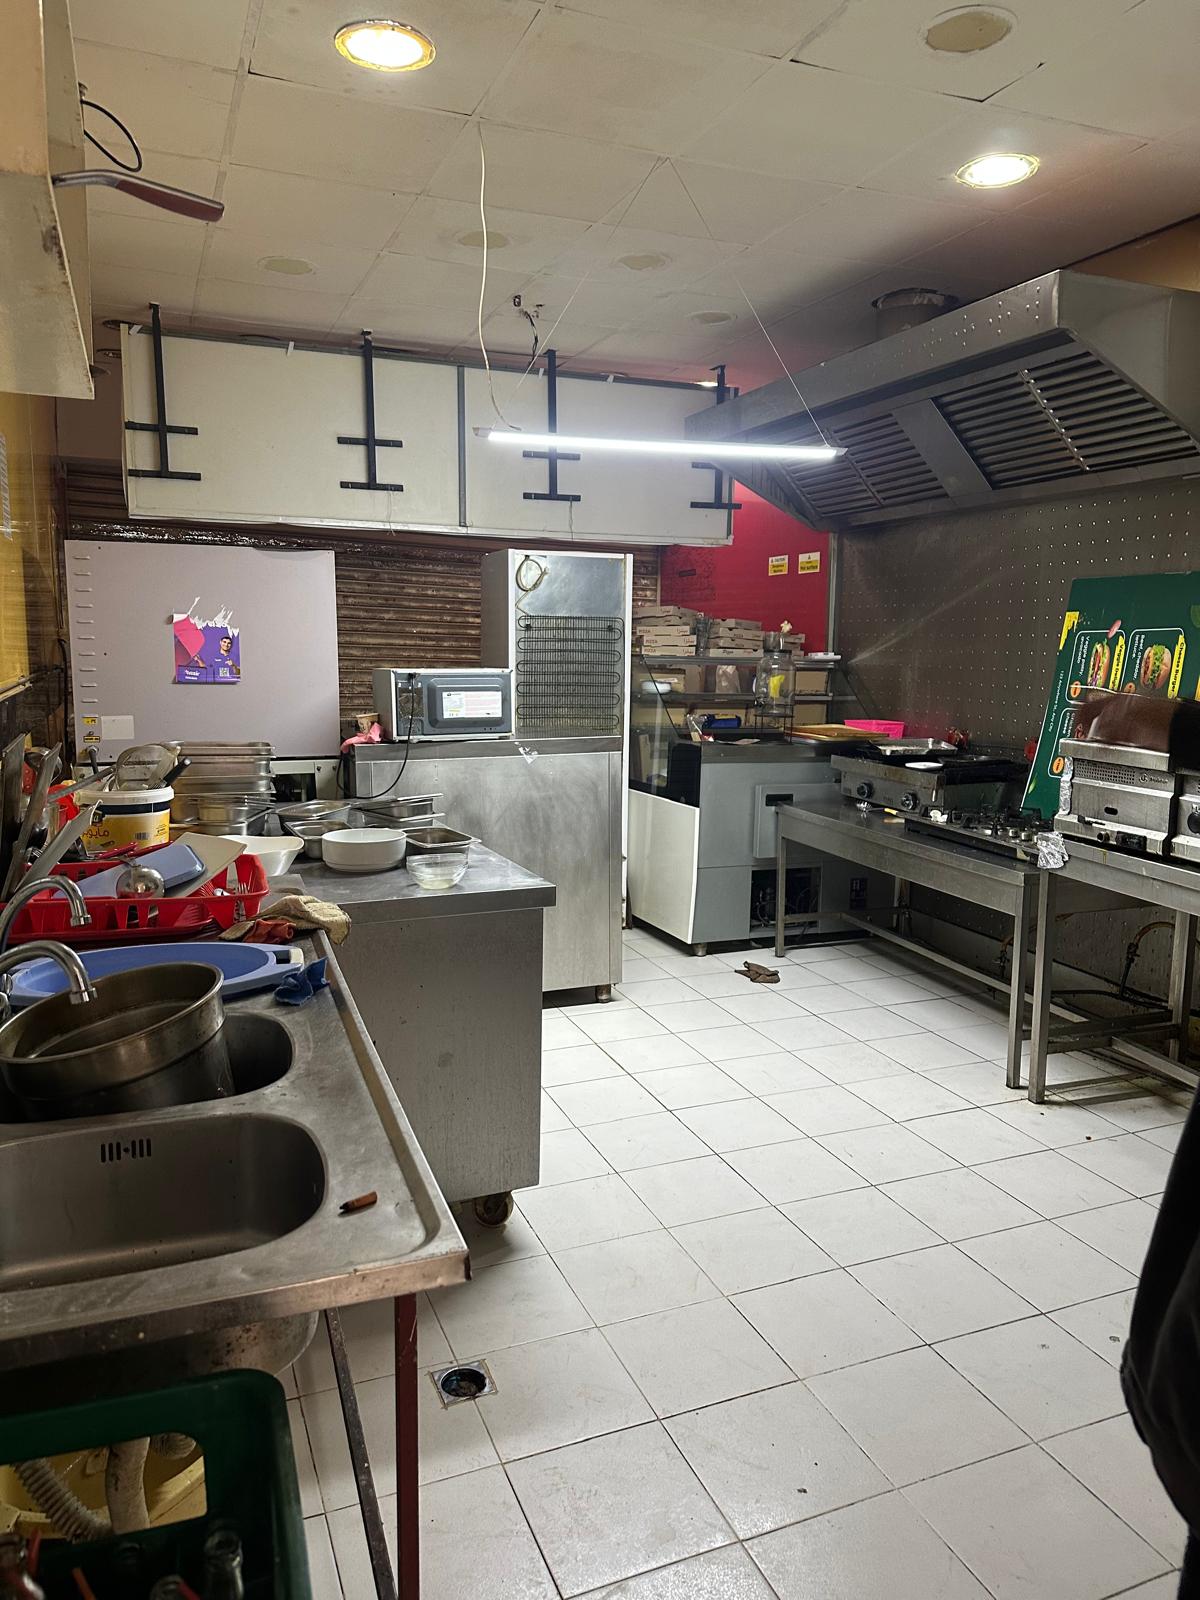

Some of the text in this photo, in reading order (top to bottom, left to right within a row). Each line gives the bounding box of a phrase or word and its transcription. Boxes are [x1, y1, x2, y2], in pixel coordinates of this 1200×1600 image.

[1081, 635, 1091, 658] Veggie
[1115, 644, 1124, 667] Veggie
[1171, 642, 1185, 693] Cheese Burger
[1054, 680, 1062, 704] Anywhere
[1062, 712, 1070, 735] cheese
